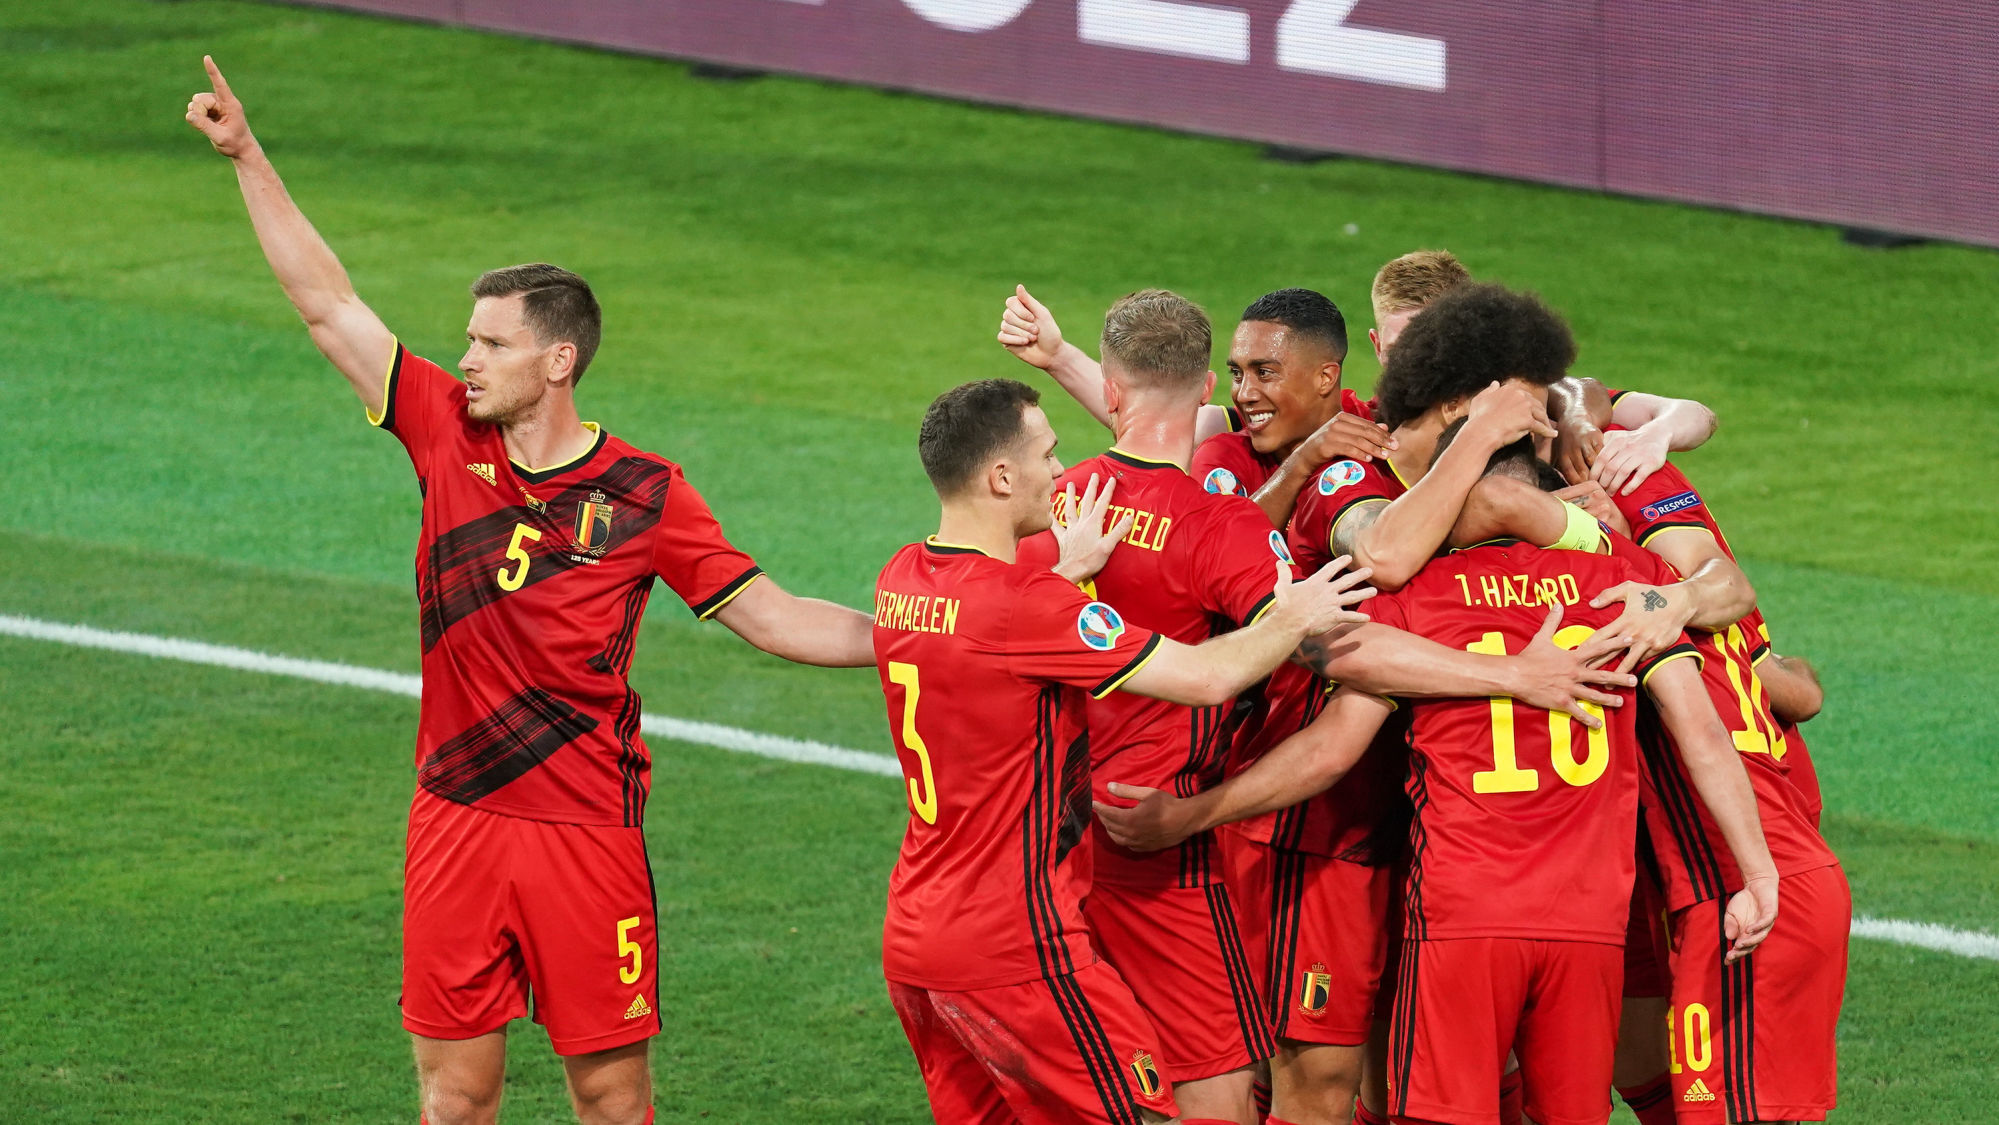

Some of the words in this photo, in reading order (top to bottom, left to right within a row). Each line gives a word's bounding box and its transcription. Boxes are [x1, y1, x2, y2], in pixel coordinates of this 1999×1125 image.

[466, 463, 498, 487] adidas
[1657, 494, 1698, 515] RESPECT
[497, 522, 542, 592] 5
[582, 556, 600, 566] YEARS
[874, 589, 961, 635] VERMAELEN
[888, 660, 938, 825] 3
[616, 916, 643, 985] 5
[623, 1005, 652, 1020] adidas
[1667, 1002, 1713, 1075] 10
[1683, 1092, 1716, 1102] adidas
